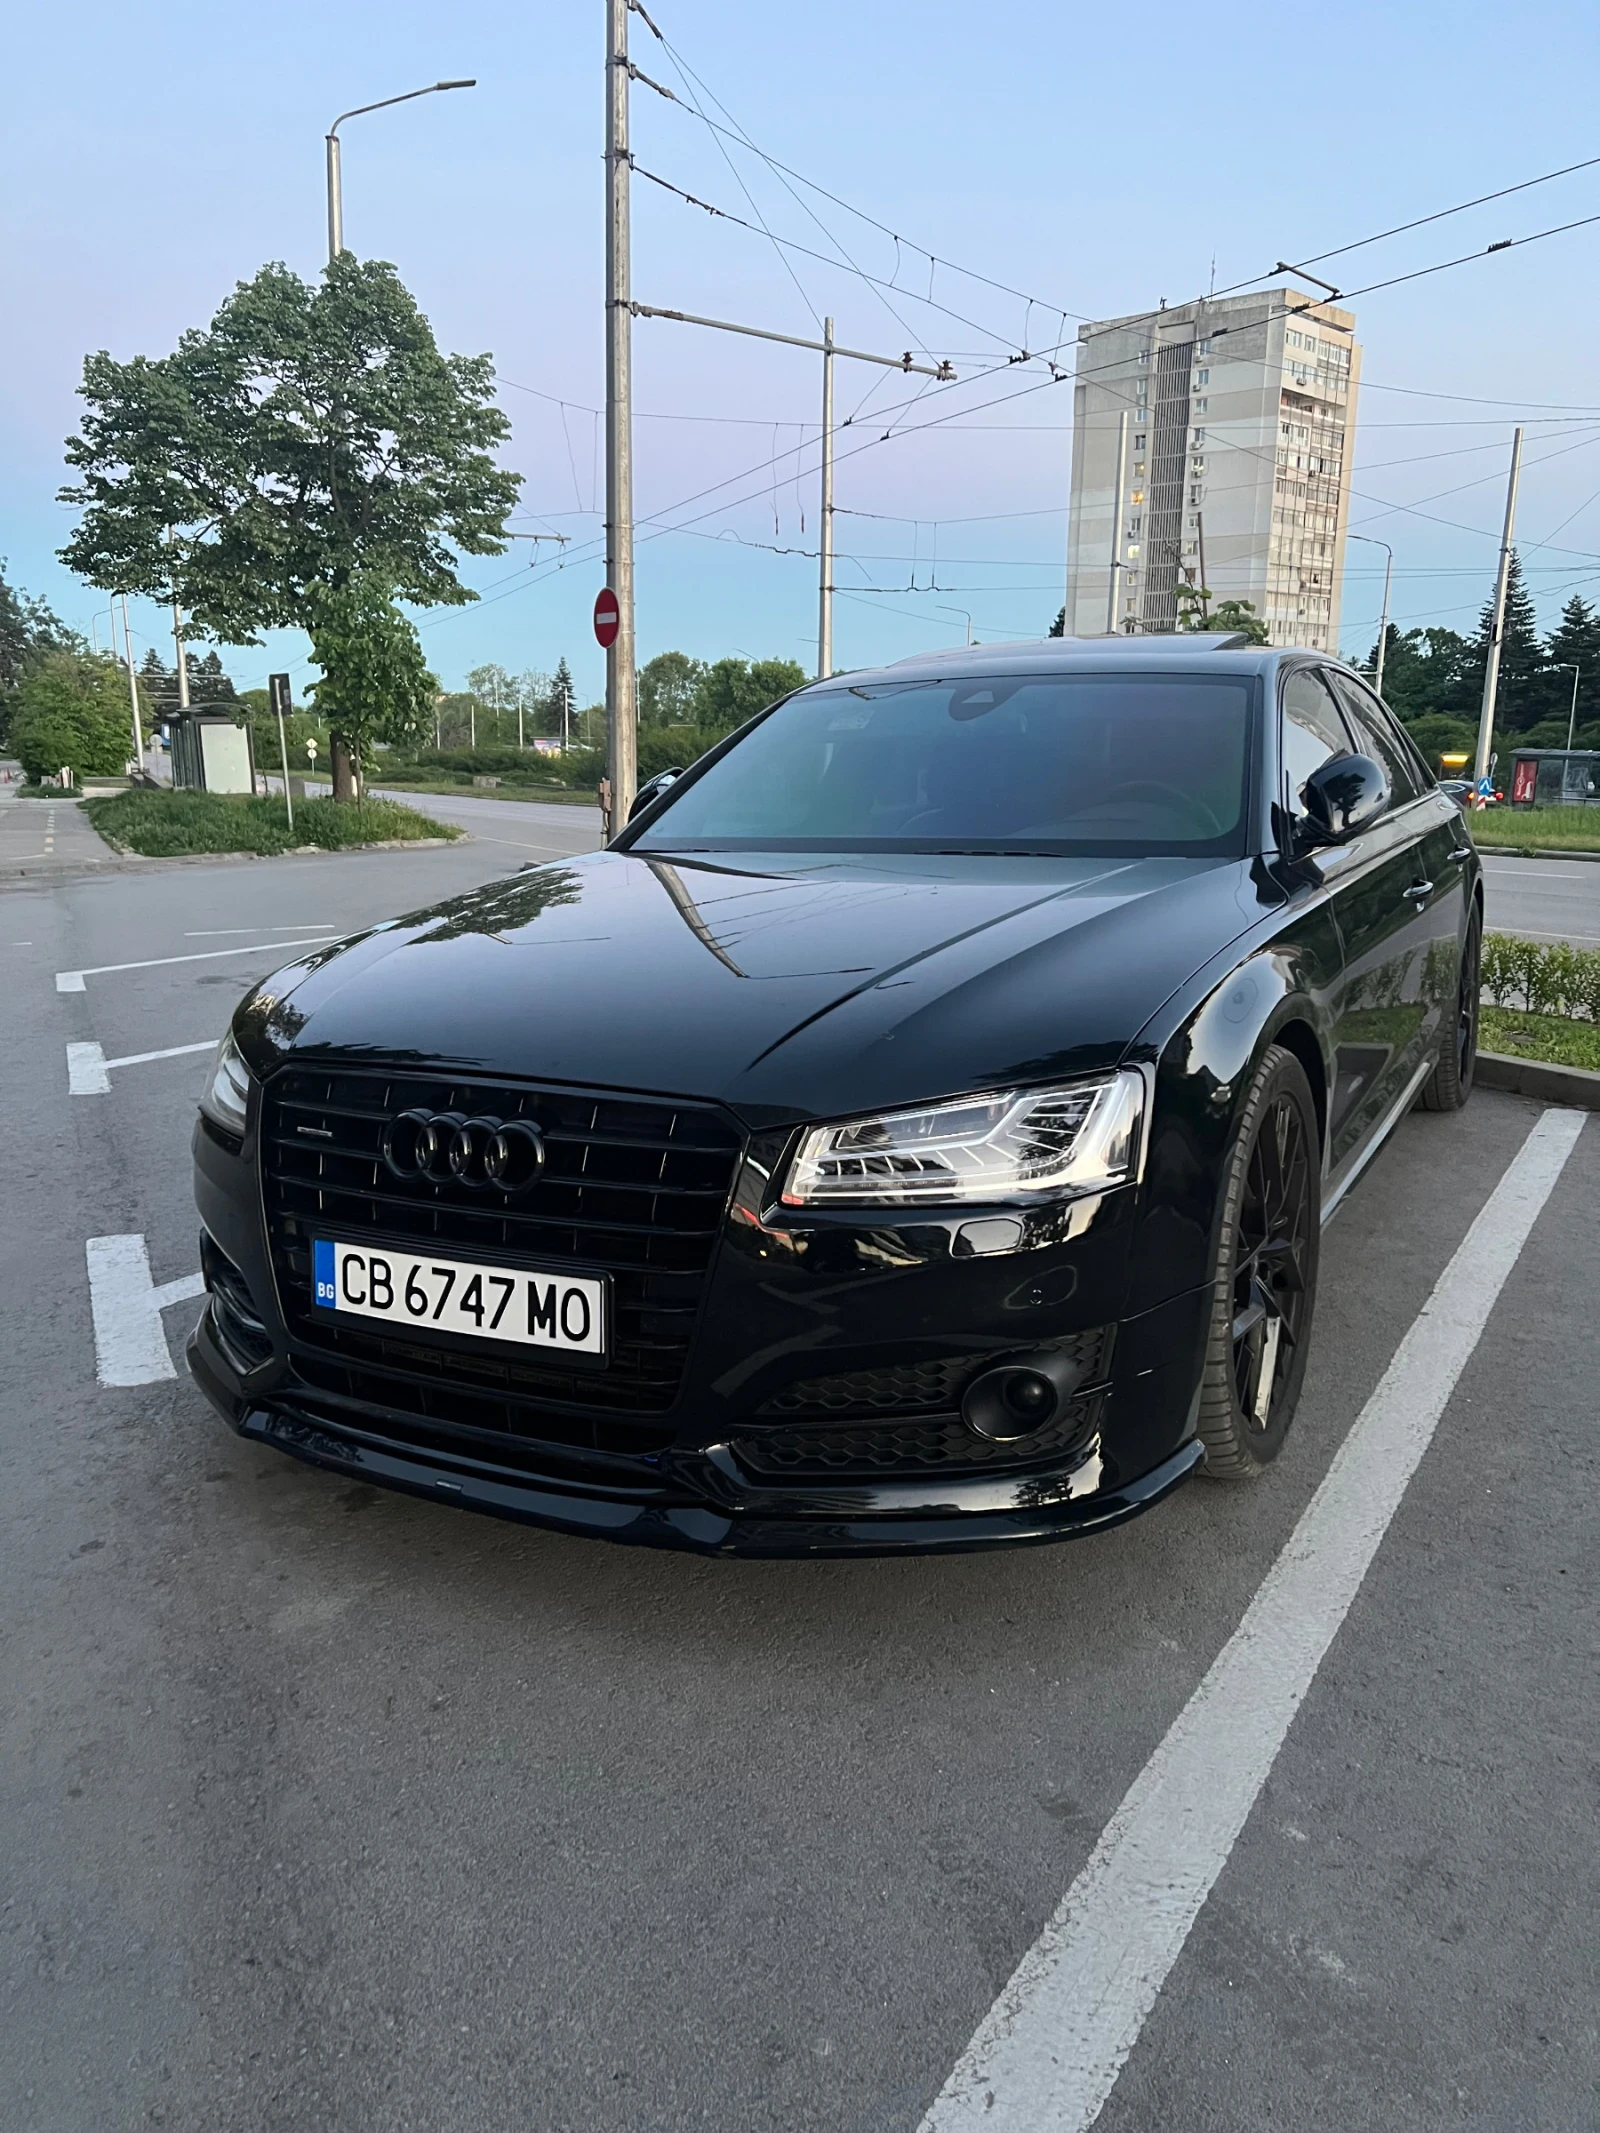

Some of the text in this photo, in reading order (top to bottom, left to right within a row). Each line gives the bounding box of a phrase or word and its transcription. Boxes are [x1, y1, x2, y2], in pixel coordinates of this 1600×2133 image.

[317, 1282, 334, 1299] BG
[341, 1253, 591, 1341] CB 6747 MO
